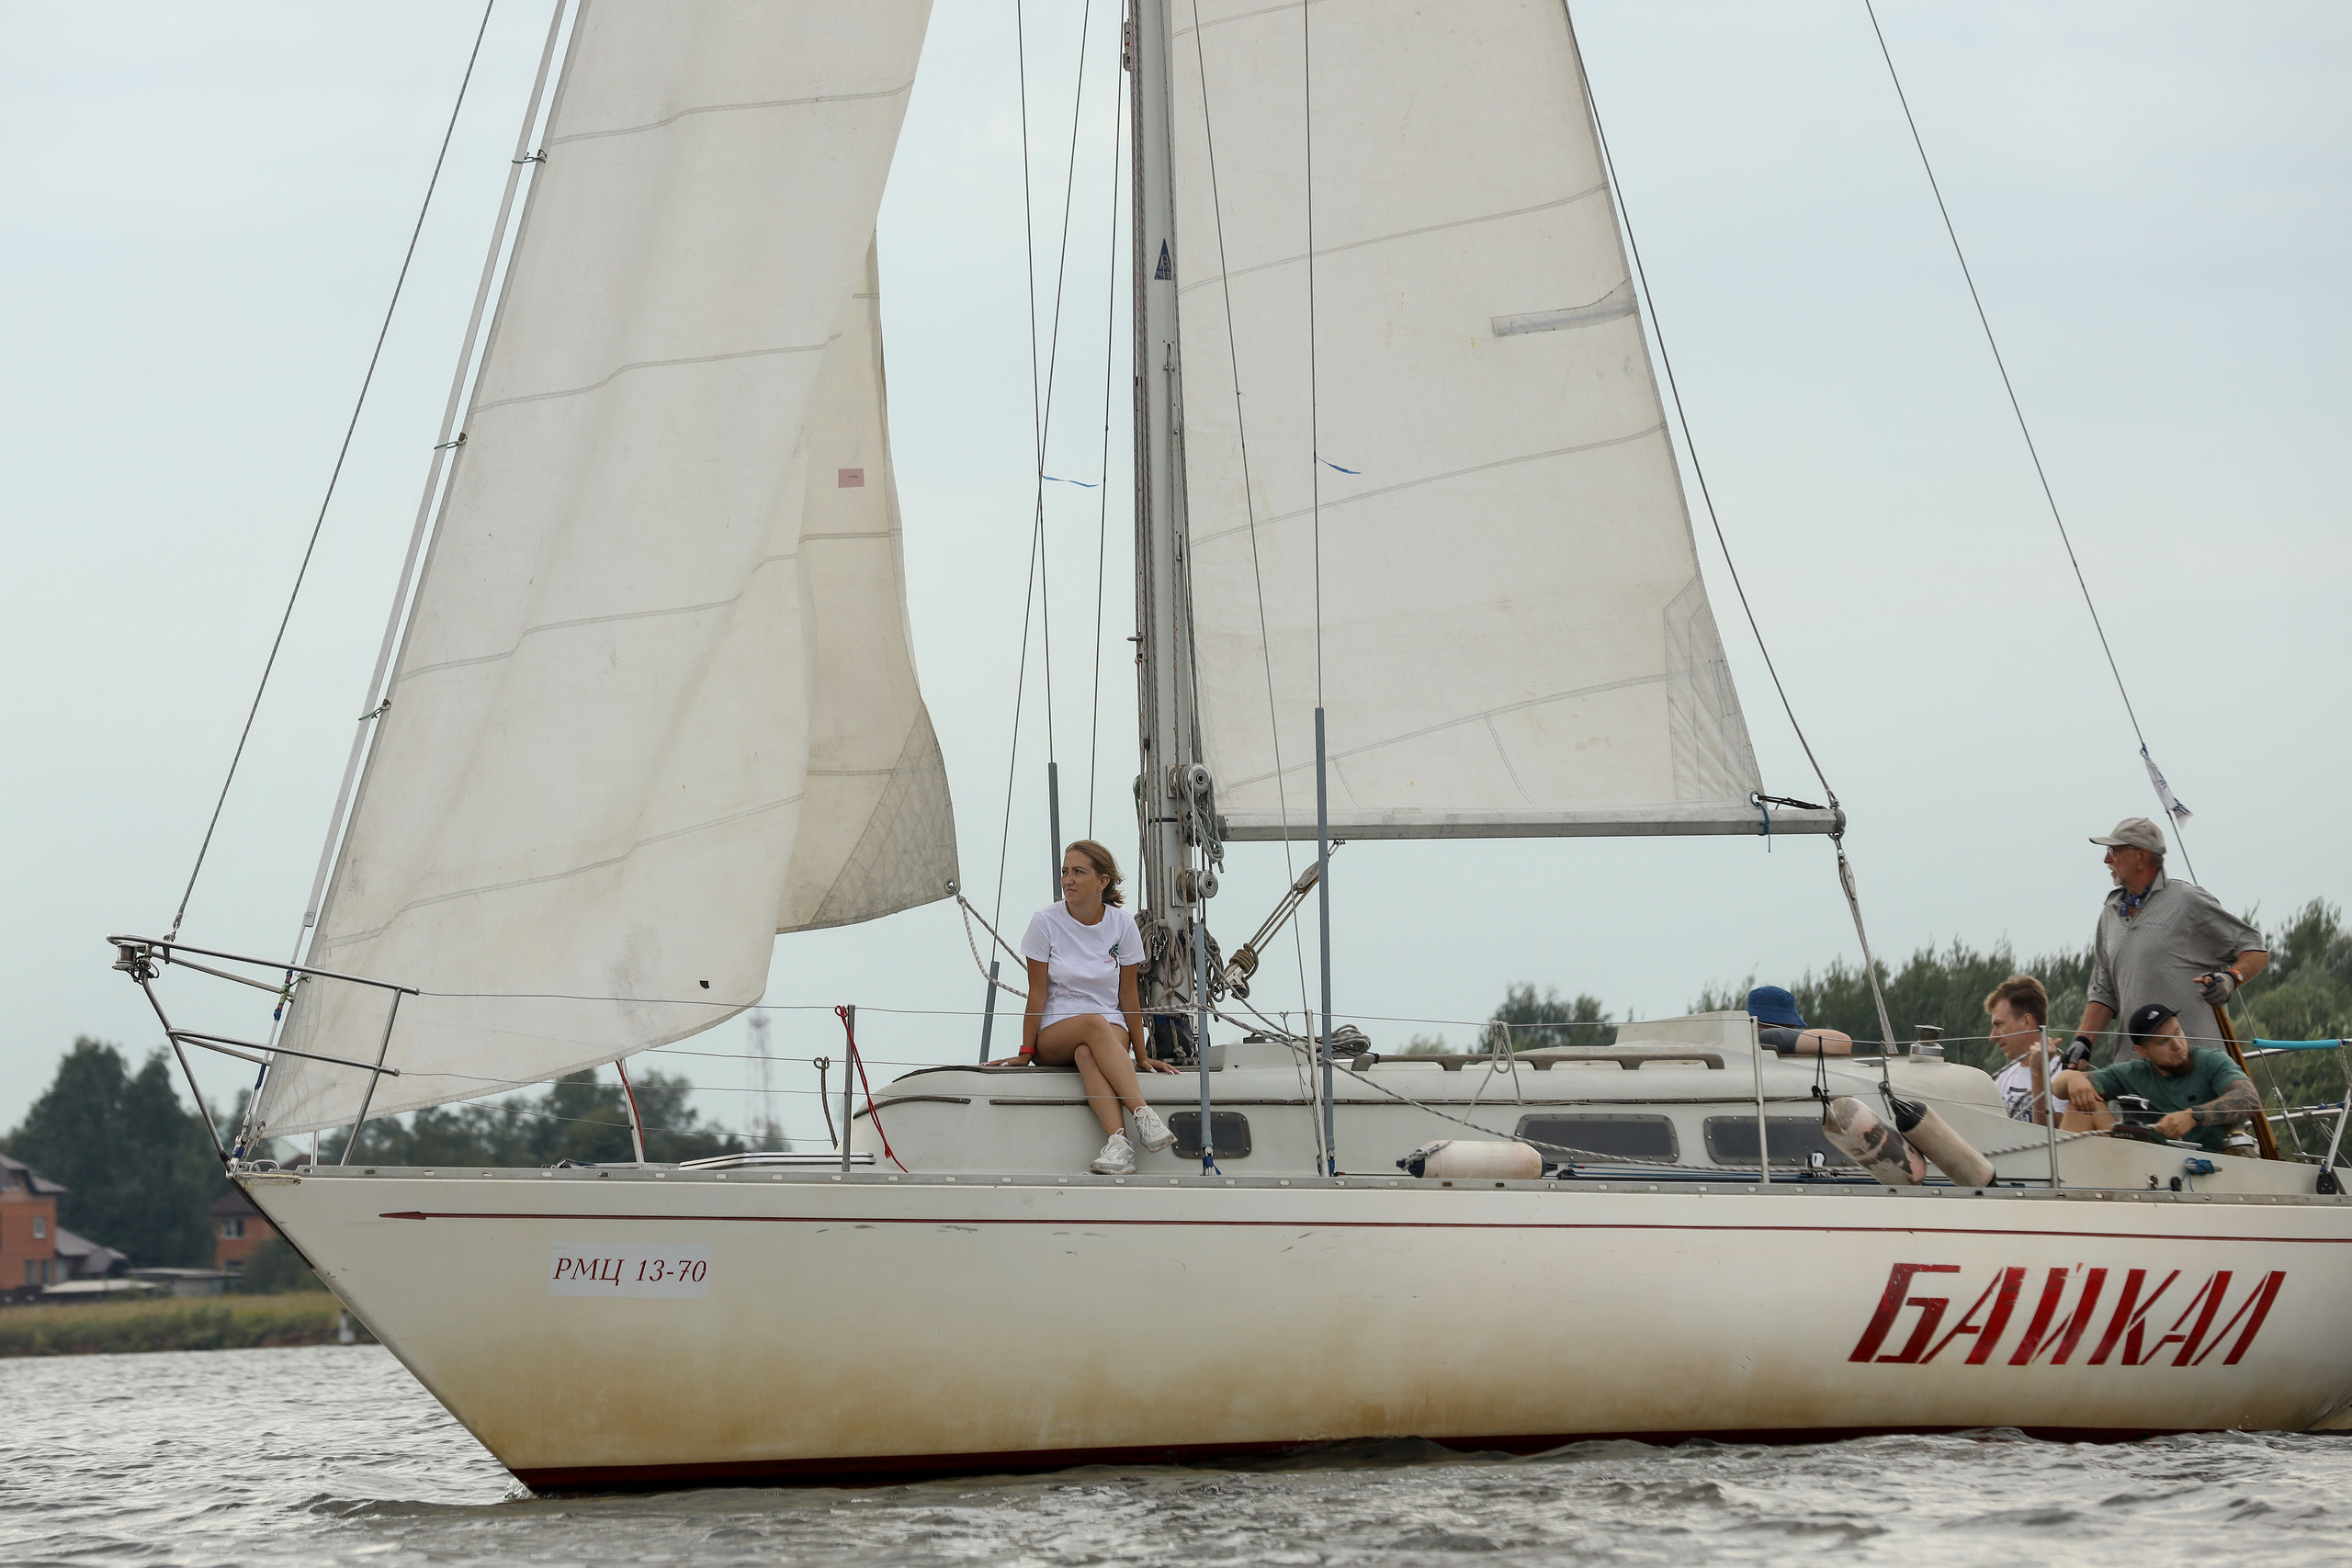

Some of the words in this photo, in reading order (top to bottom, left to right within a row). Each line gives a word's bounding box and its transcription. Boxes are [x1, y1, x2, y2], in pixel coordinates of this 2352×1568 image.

[553, 1258, 626, 1286] РМЦ
[636, 1259, 707, 1282] 13-70
[1848, 1262, 2287, 1367] БАЙКАЛ
